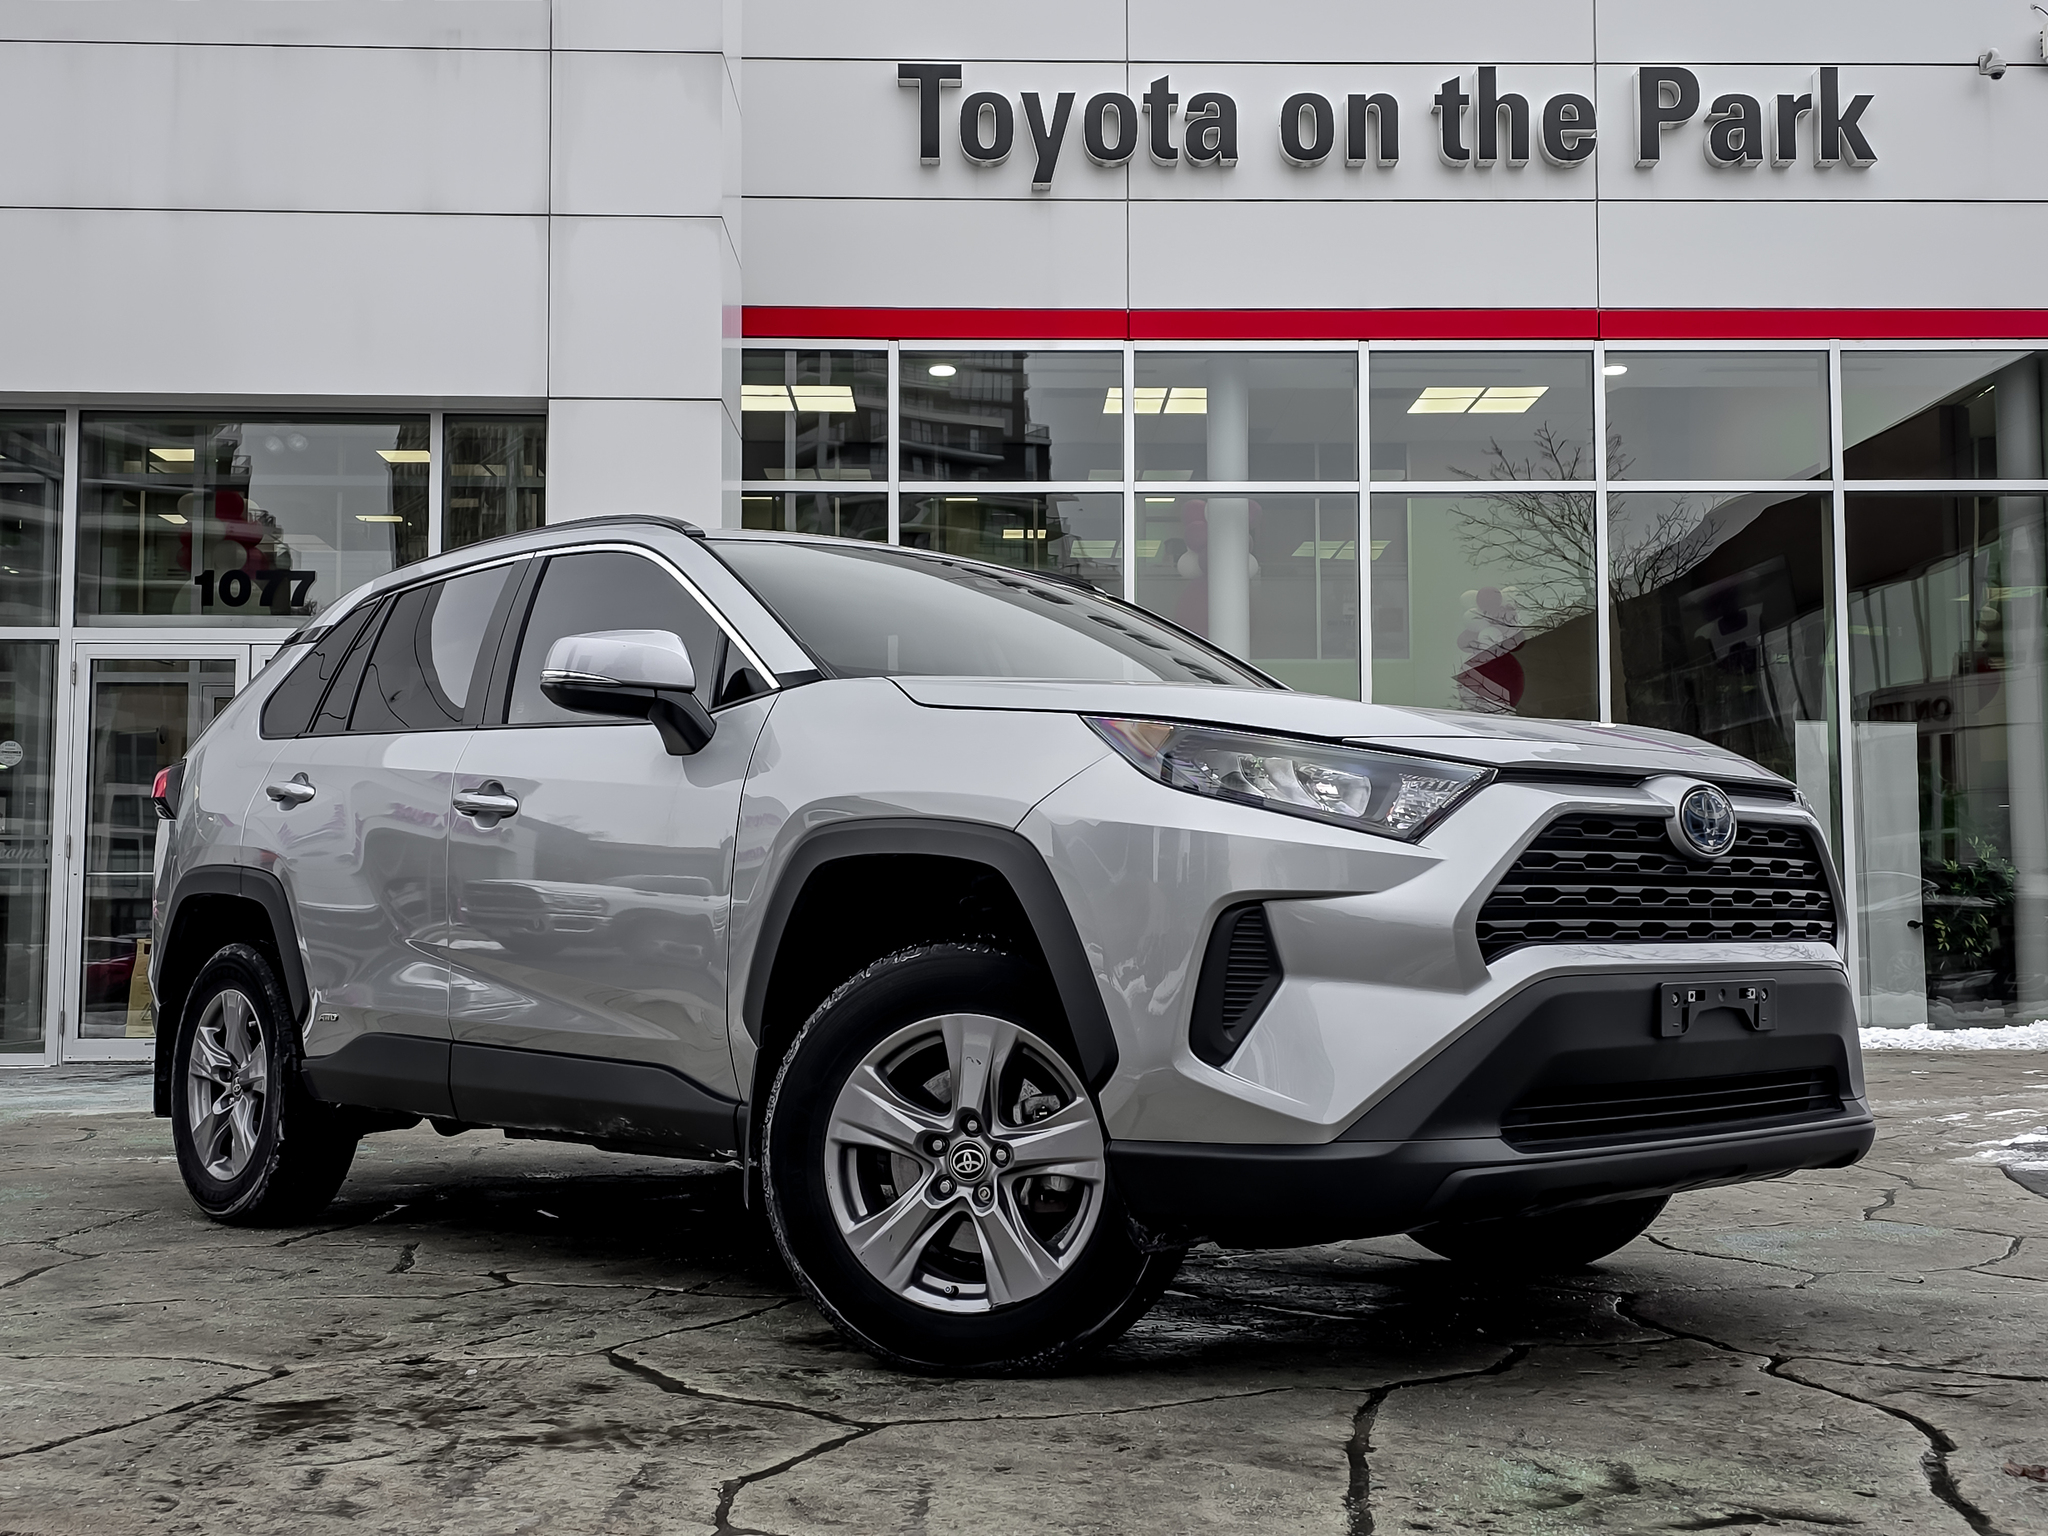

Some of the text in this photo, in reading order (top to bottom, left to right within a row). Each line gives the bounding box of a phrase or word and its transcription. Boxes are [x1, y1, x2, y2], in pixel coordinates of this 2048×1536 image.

[897, 63, 1878, 189] Toyota on the Park
[194, 569, 316, 607] 1077
